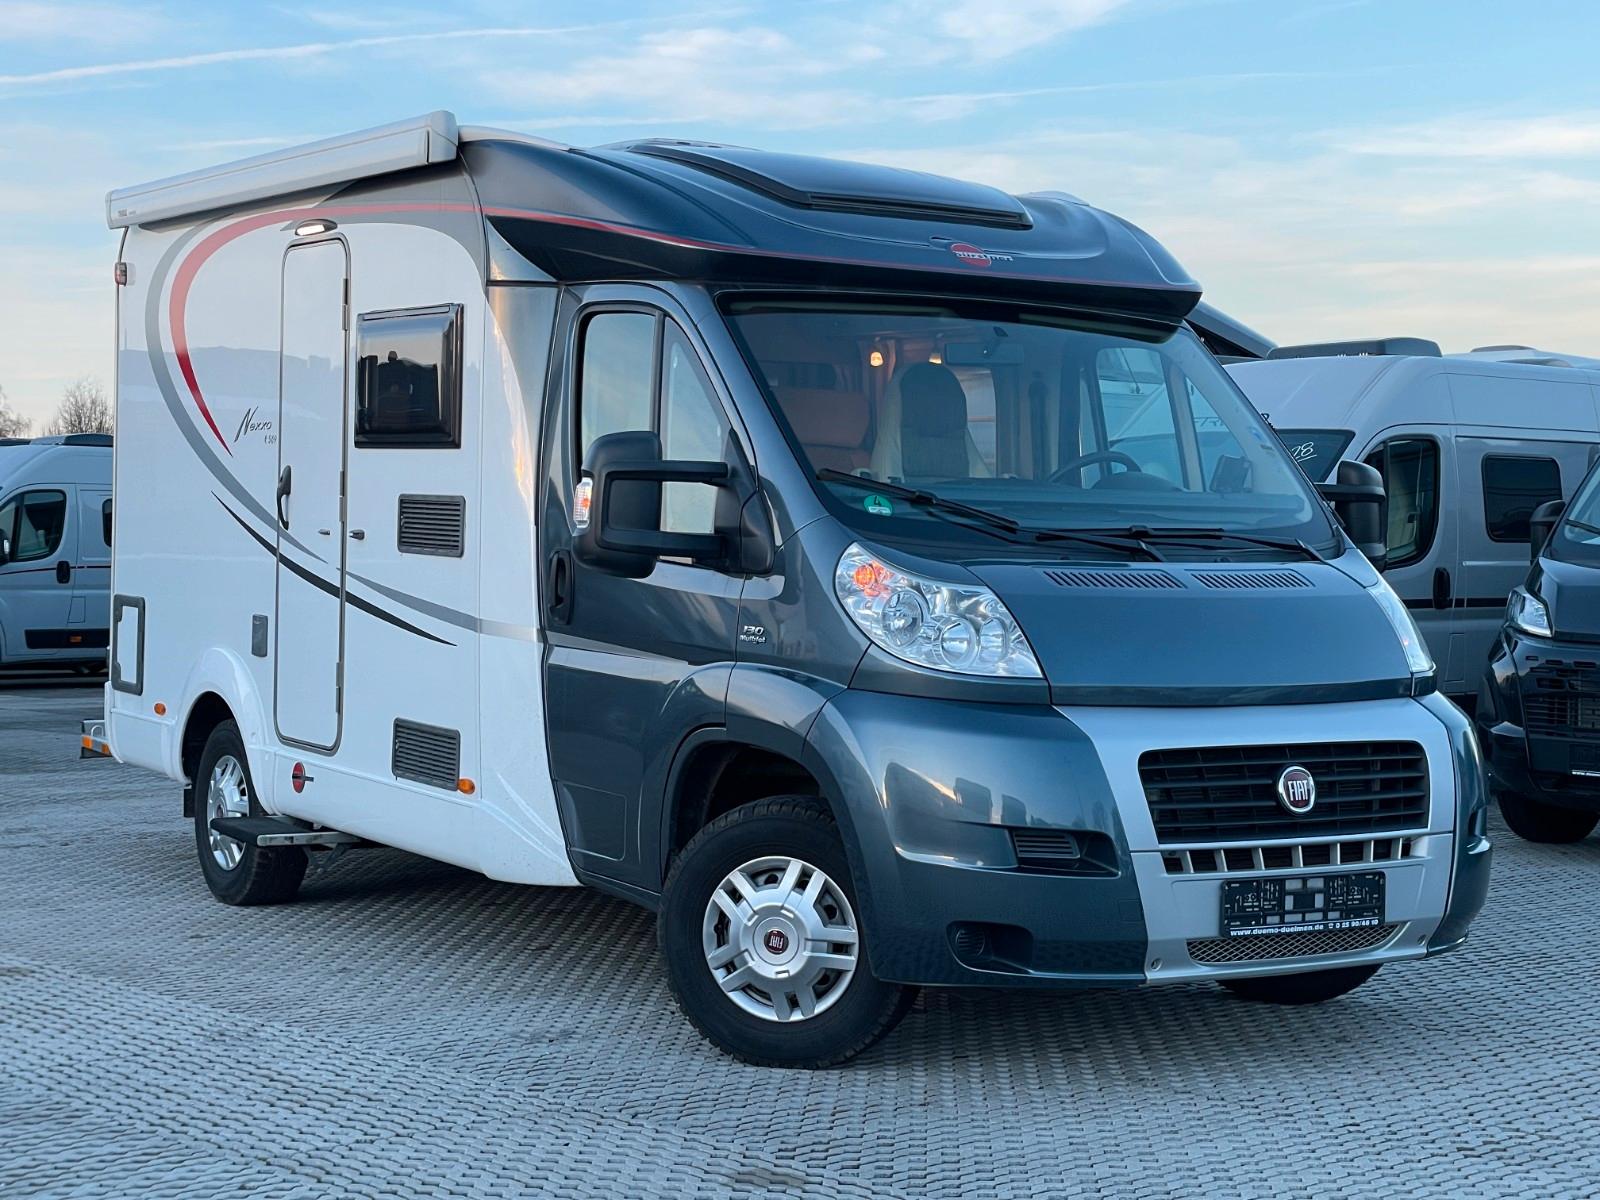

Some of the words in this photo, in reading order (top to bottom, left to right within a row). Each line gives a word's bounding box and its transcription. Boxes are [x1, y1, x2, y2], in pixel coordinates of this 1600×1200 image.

[234, 406, 272, 442] Nexxo
[873, 494, 882, 506] 4
[743, 625, 764, 636] 130
[1287, 779, 1309, 801] FIAT
[769, 935, 784, 949] FIAT
